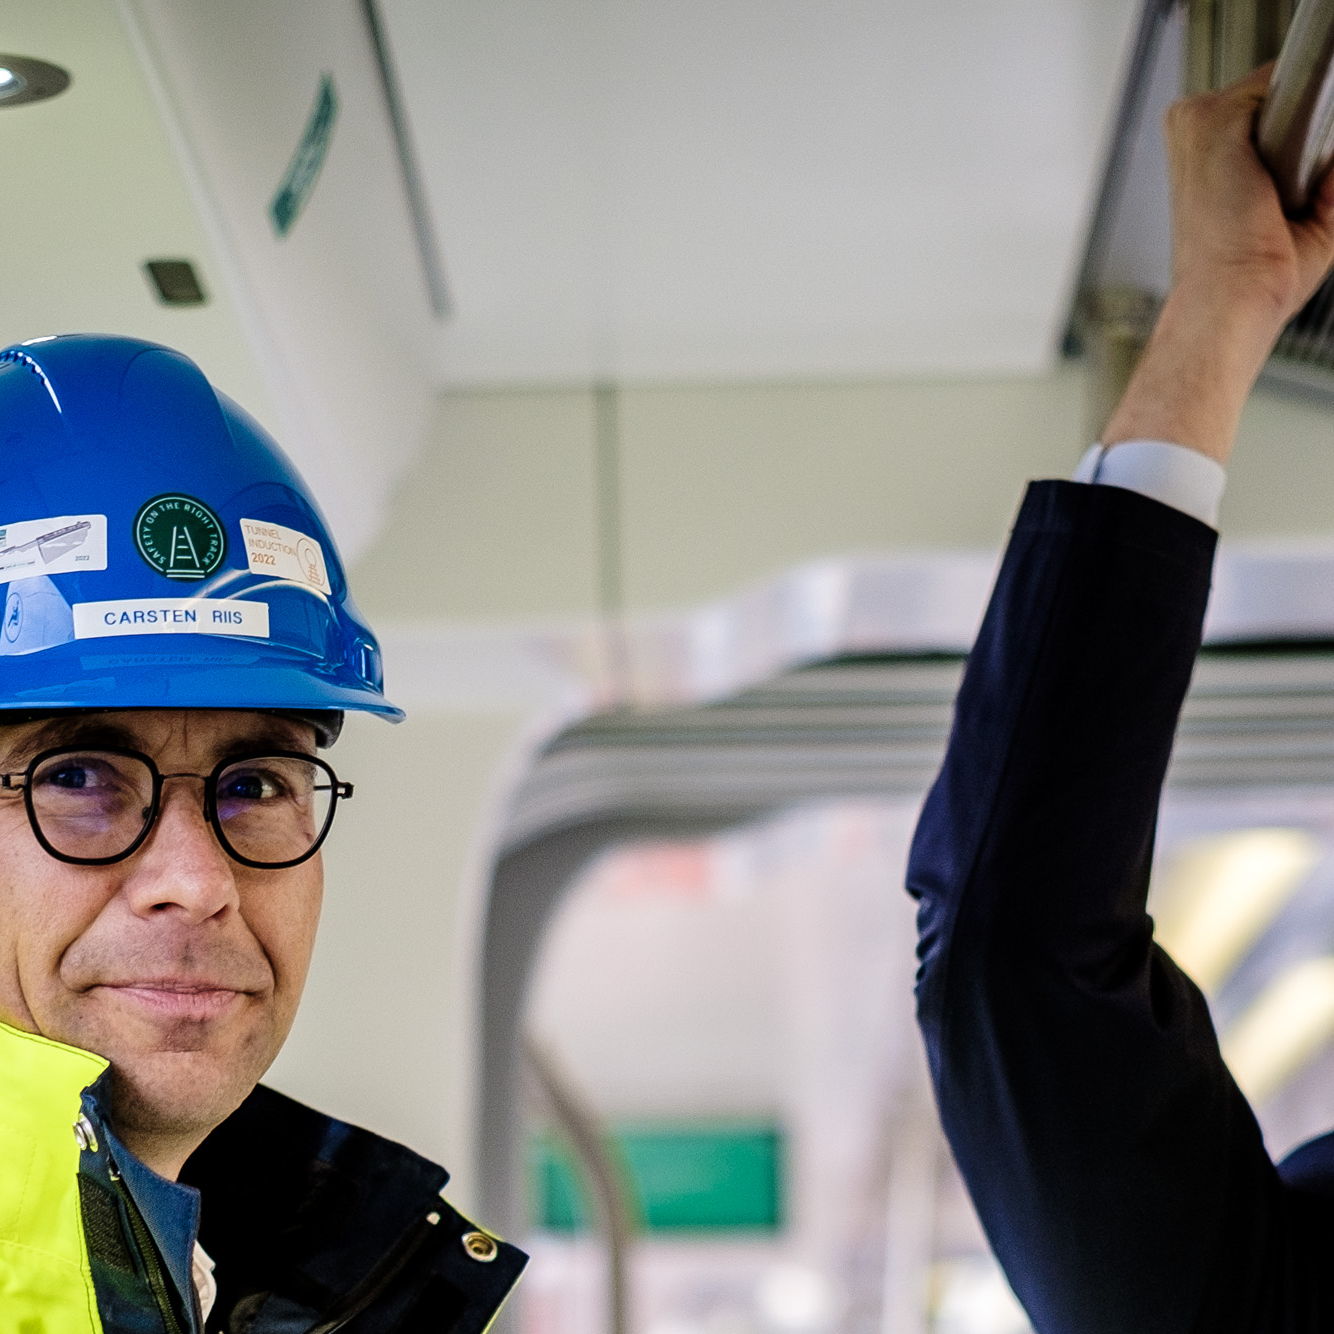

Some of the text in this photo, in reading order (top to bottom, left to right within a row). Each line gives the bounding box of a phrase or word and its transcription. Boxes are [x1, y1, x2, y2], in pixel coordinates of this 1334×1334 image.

[143, 502, 219, 565] SAFETY ON THE RIGHT TRACK
[244, 524, 282, 540] TUNNEL
[248, 538, 297, 557] INDUCTION
[251, 552, 276, 566] 2022
[104, 609, 243, 625] CARSTEN RIIS
